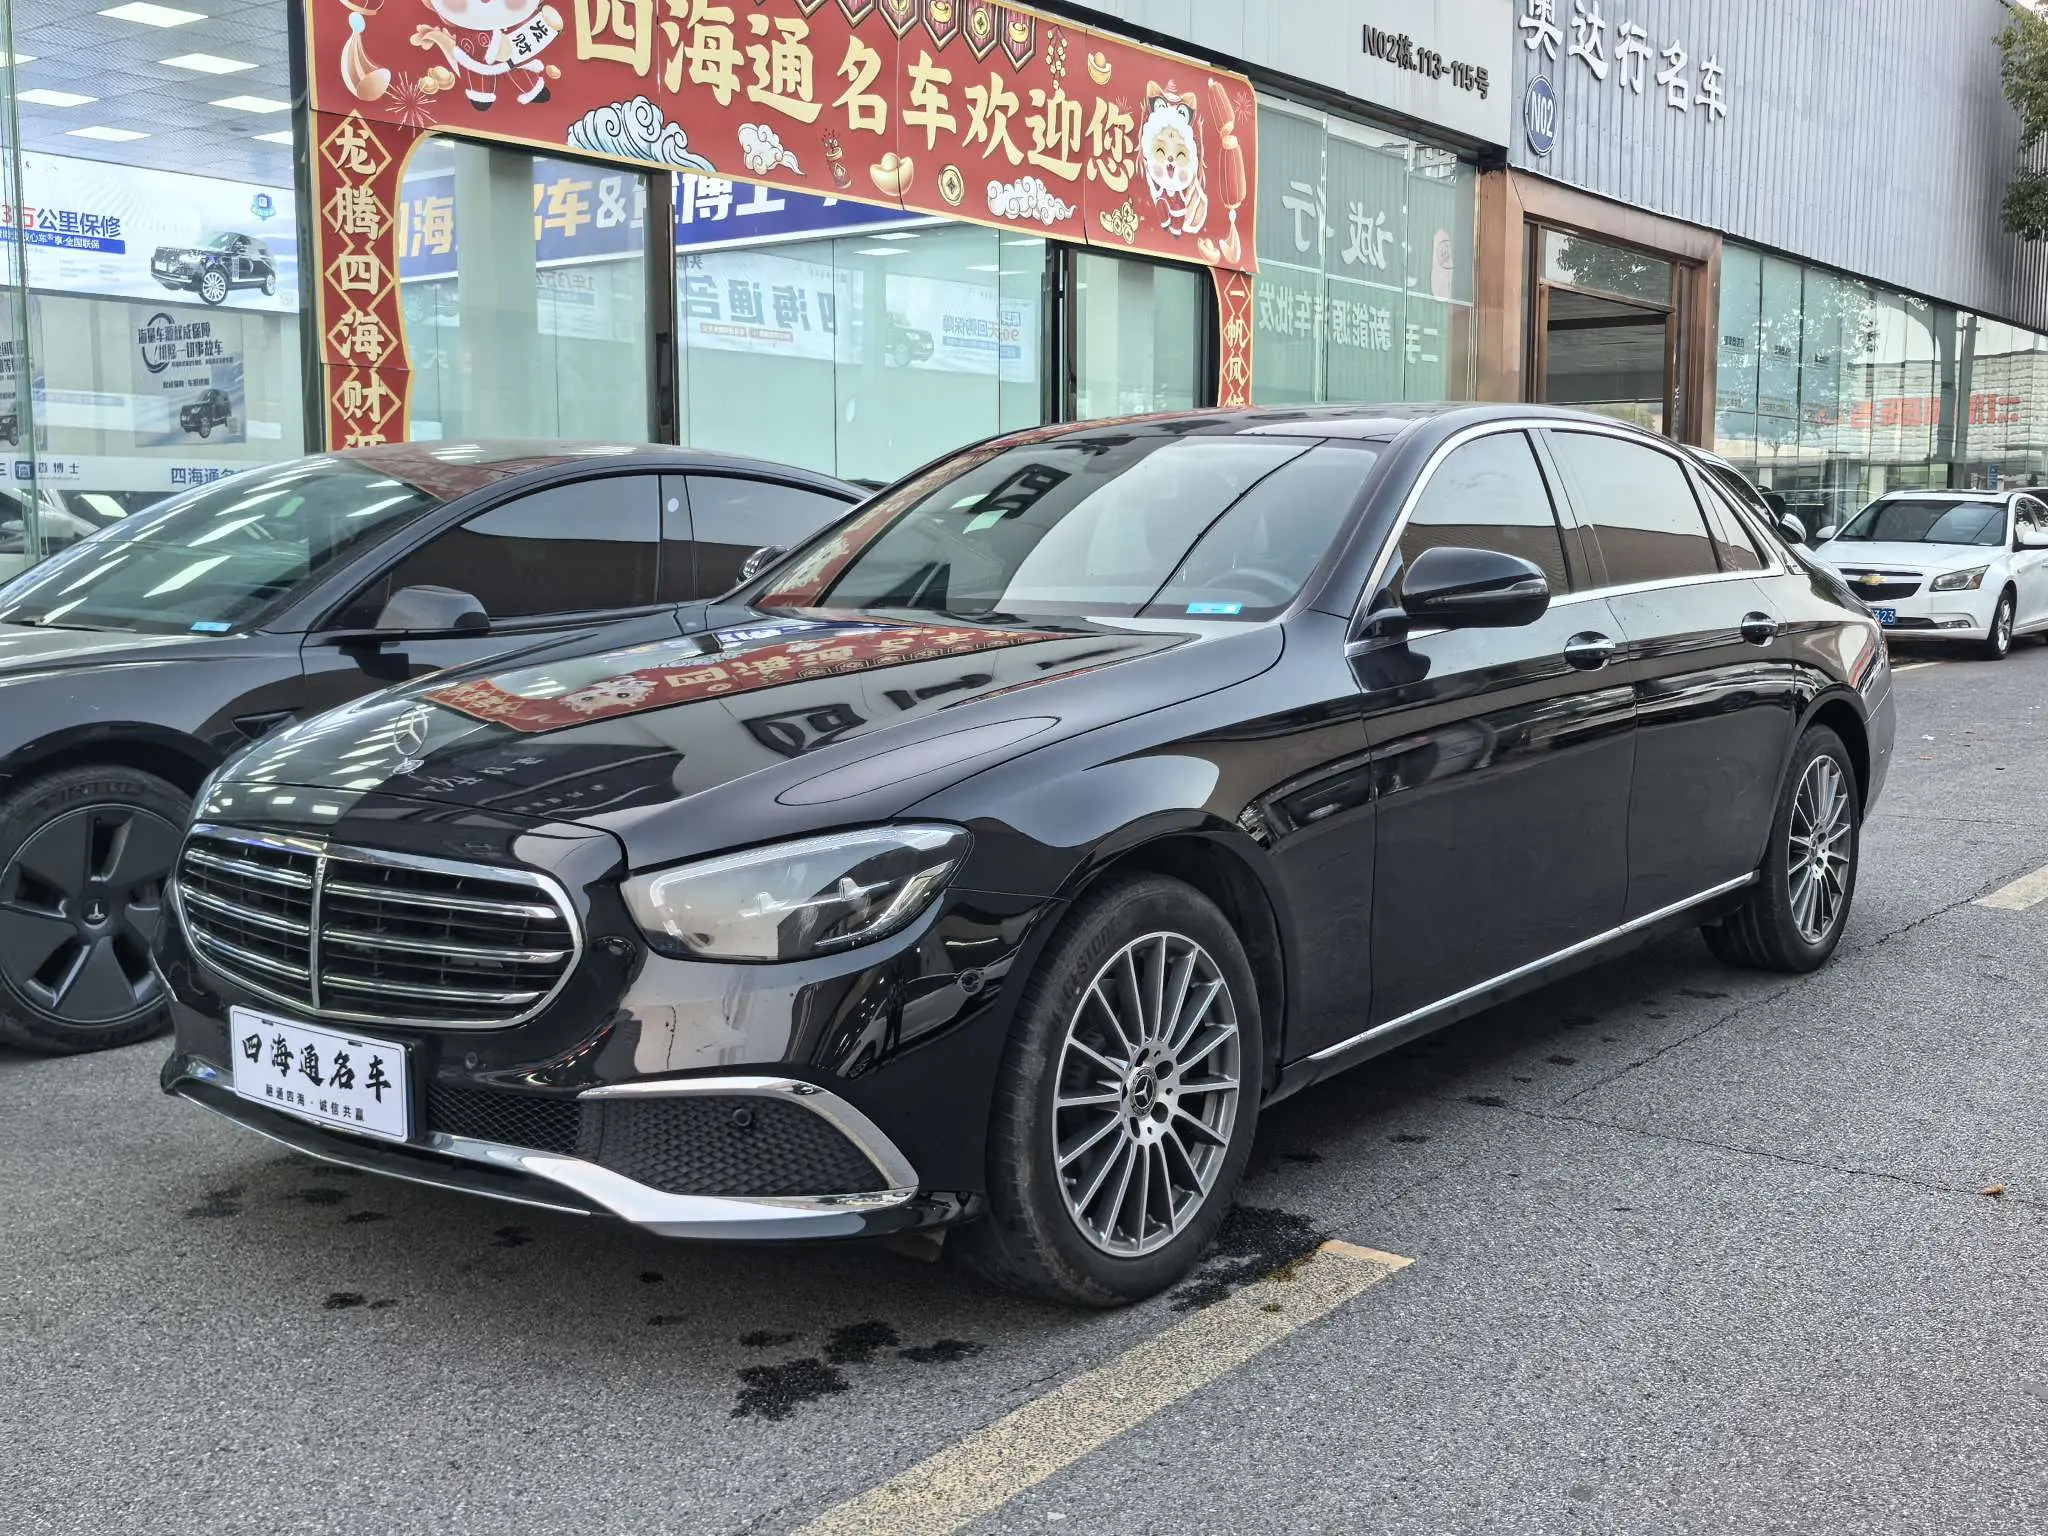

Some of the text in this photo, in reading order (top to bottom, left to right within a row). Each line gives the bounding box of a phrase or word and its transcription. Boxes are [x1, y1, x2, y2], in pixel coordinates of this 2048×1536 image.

[512, 20, 549, 56] 发财
[1519, 0, 1728, 122] 奥达行名车
[576, 0, 1135, 192] 四海通名车欢迎您
[242, 1033, 392, 1104] 四海通名车
